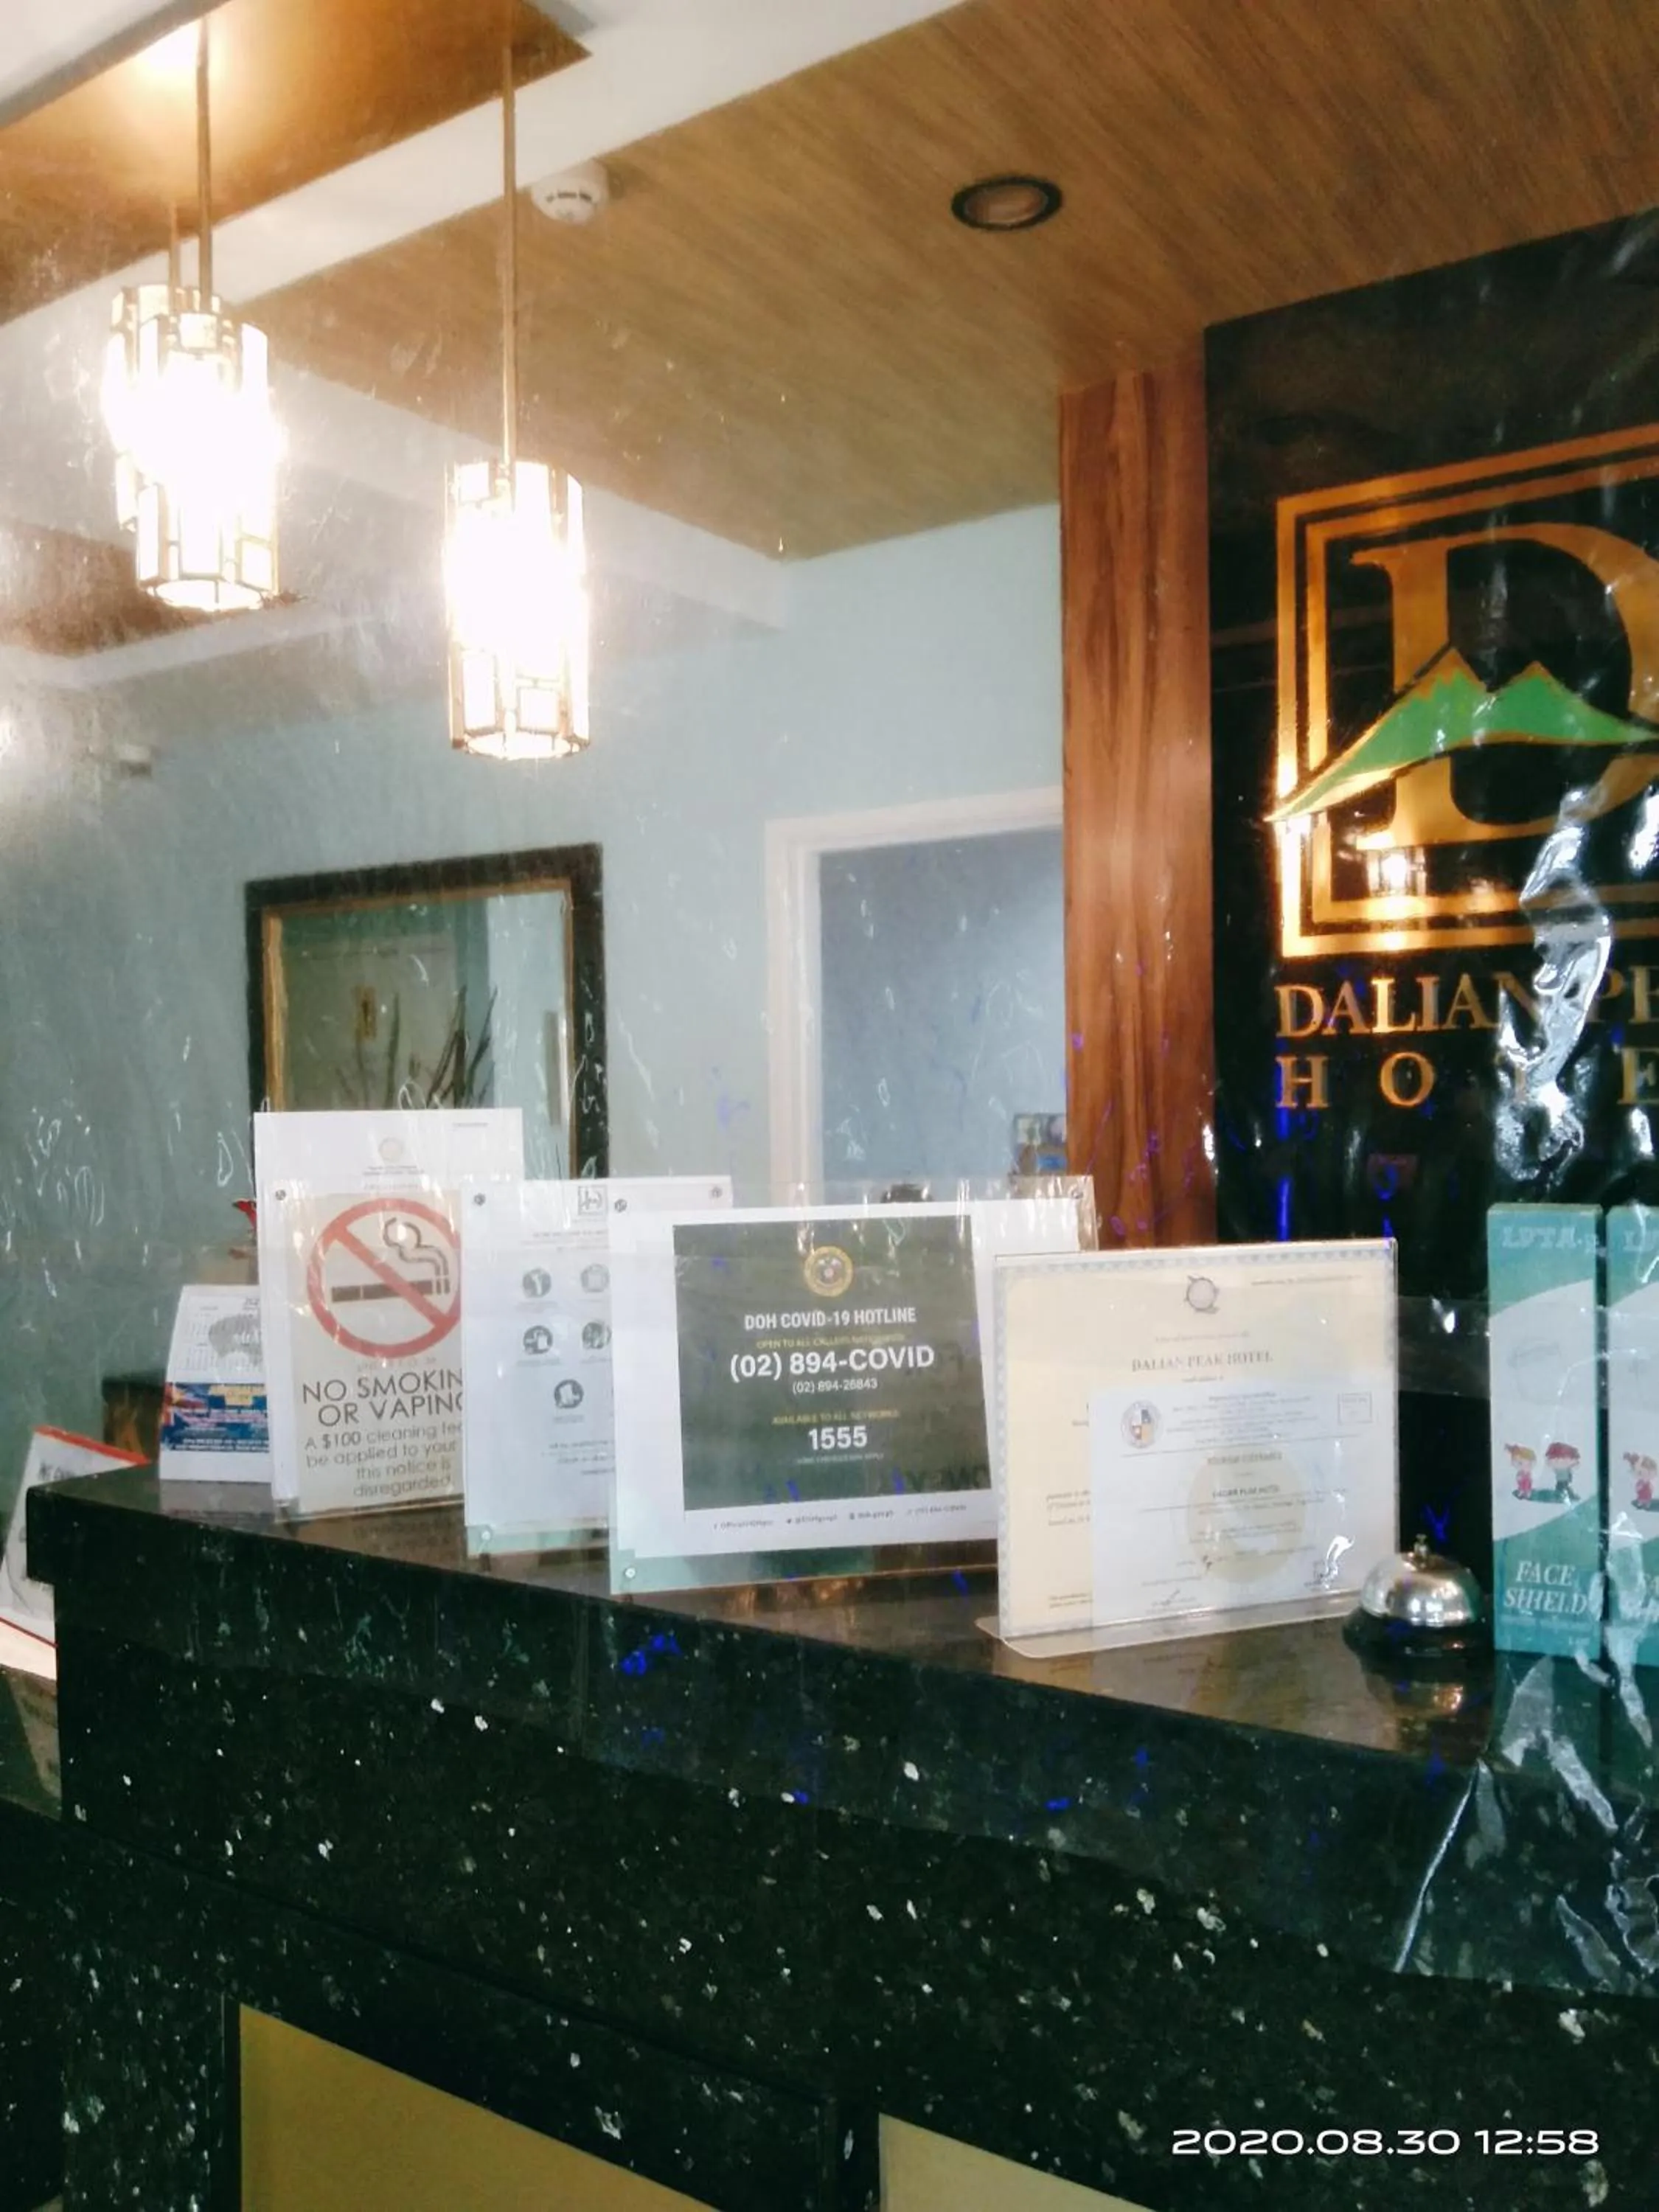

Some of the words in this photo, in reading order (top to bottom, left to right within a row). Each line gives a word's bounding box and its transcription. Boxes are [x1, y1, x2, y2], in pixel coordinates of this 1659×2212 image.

[1276, 971, 1550, 1037] DALIAN
[745, 1312, 776, 1330] DOH
[781, 1310, 850, 1329] COVID-19
[854, 1307, 916, 1326] HOTLINE
[730, 1352, 782, 1382] (02)
[790, 1344, 935, 1375] 894-COVID
[302, 1379, 347, 1404] NO
[793, 1381, 815, 1394] (02)
[318, 1402, 360, 1427] OR
[305, 1436, 317, 1451] A
[322, 1430, 361, 1450] $100
[366, 1423, 437, 1444] cleaning
[808, 1425, 868, 1450] 1555
[306, 1454, 330, 1469] be
[333, 1444, 397, 1467] applied
[403, 1443, 419, 1458] to
[424, 1439, 457, 1457] your
[356, 1464, 381, 1480] this
[386, 1456, 437, 1476] notice
[352, 1474, 451, 1498] disregarded
[1515, 1559, 1576, 1587] FACE
[1503, 1587, 1587, 1615] SHIELD
